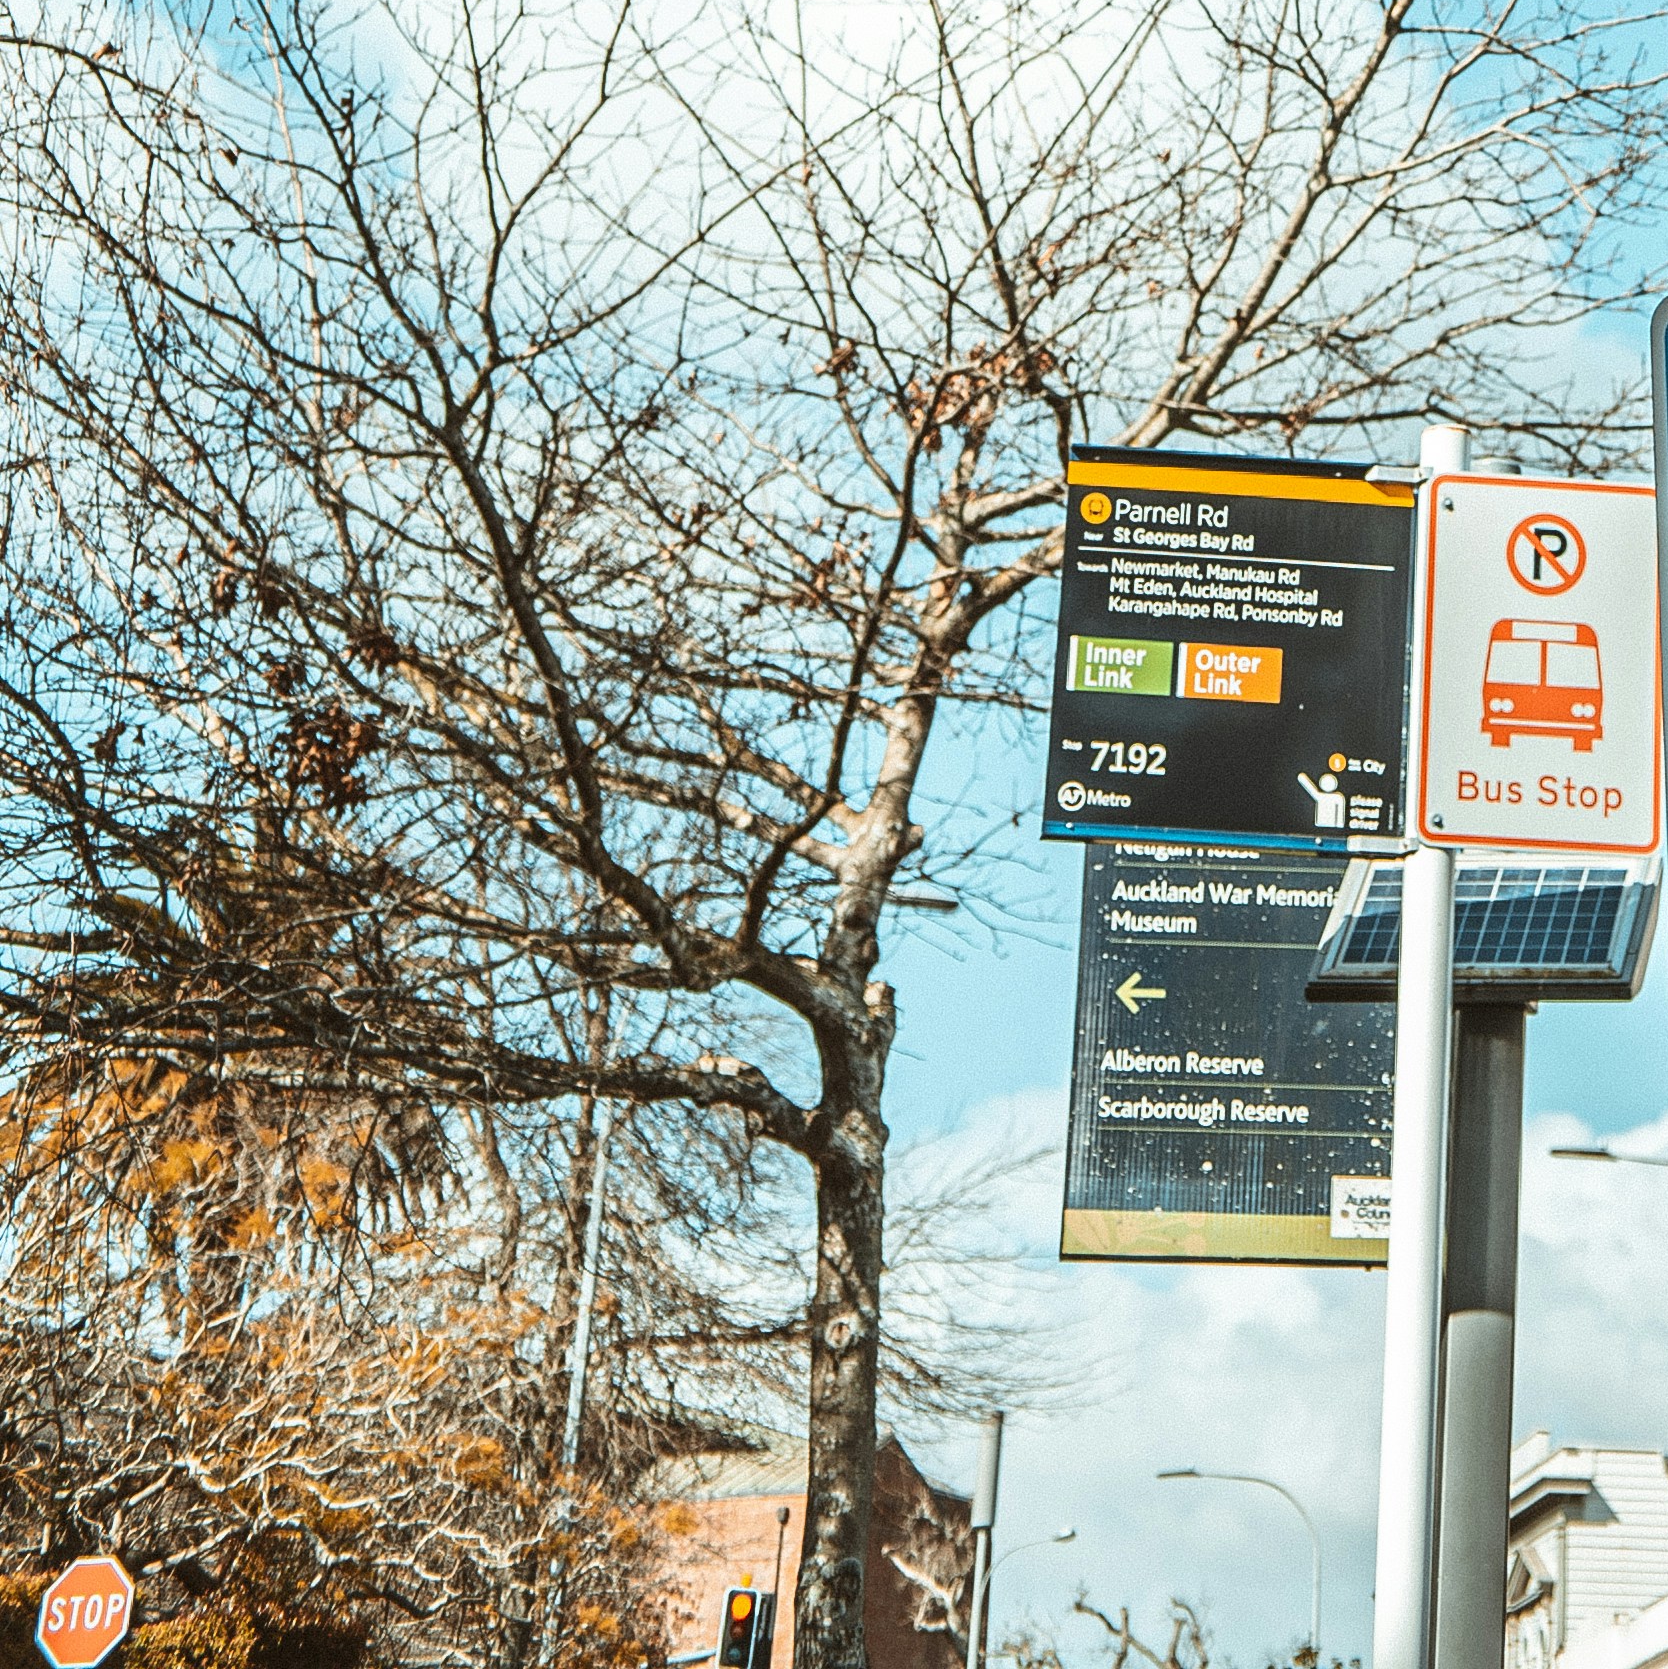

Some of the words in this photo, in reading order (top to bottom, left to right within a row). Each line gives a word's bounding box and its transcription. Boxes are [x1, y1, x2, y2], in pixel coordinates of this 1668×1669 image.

[1115, 498, 1192, 525] Parnell
[1197, 503, 1229, 528] Rd
[1113, 526, 1132, 543] St
[1132, 527, 1198, 549] Georges
[1199, 531, 1230, 552] Bay
[1231, 534, 1255, 551] Rd
[1111, 557, 1204, 580] Newmarket,
[1206, 563, 1276, 584] Manukau
[1278, 568, 1301, 586] Rd
[1109, 576, 1131, 594] Mt
[1133, 577, 1177, 598] Eden,
[1179, 581, 1253, 601] Auckland
[1255, 586, 1319, 606] Hospital
[1108, 595, 1211, 620] Karangahape
[1213, 602, 1239, 622] Rd,
[1241, 603, 1319, 628] Ponsonby
[1320, 608, 1344, 627] Rd
[1085, 641, 1147, 667] Inner
[1194, 648, 1262, 674] Outer
[1083, 664, 1133, 689] Link
[1193, 672, 1243, 696] Link
[1090, 740, 1168, 776] 7192
[1086, 788, 1132, 808] Metro
[1456, 770, 1524, 805] Bus
[1537, 774, 1625, 818] Stop
[1111, 879, 1205, 904] Auckland
[1208, 881, 1254, 905] War
[1110, 909, 1198, 934] Museum
[1100, 1047, 1181, 1073] Alberon
[1185, 1050, 1265, 1076] Reserve
[1098, 1095, 1226, 1127] Scarborough
[1230, 1098, 1310, 1124] Reserve
[47, 1593, 126, 1632] STOP
